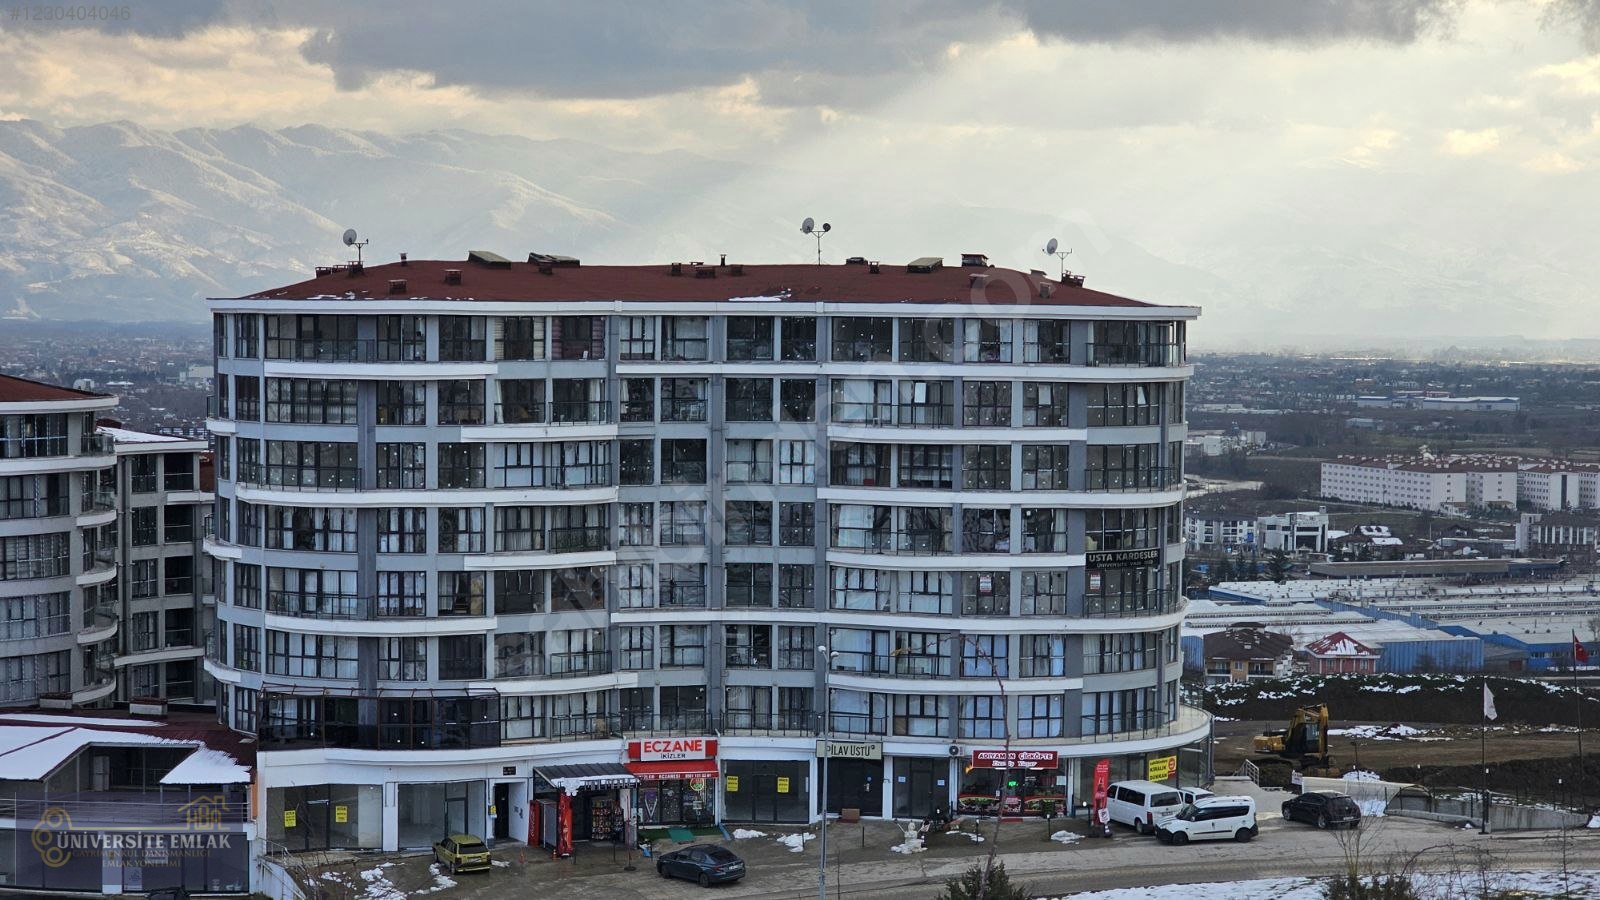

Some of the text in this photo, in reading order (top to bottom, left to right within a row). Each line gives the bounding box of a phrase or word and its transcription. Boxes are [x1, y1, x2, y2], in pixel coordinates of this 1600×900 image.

[1089, 554, 1113, 562] USTA
[644, 739, 703, 753] ECZANE
[978, 752, 1016, 760] ADIYAMN
